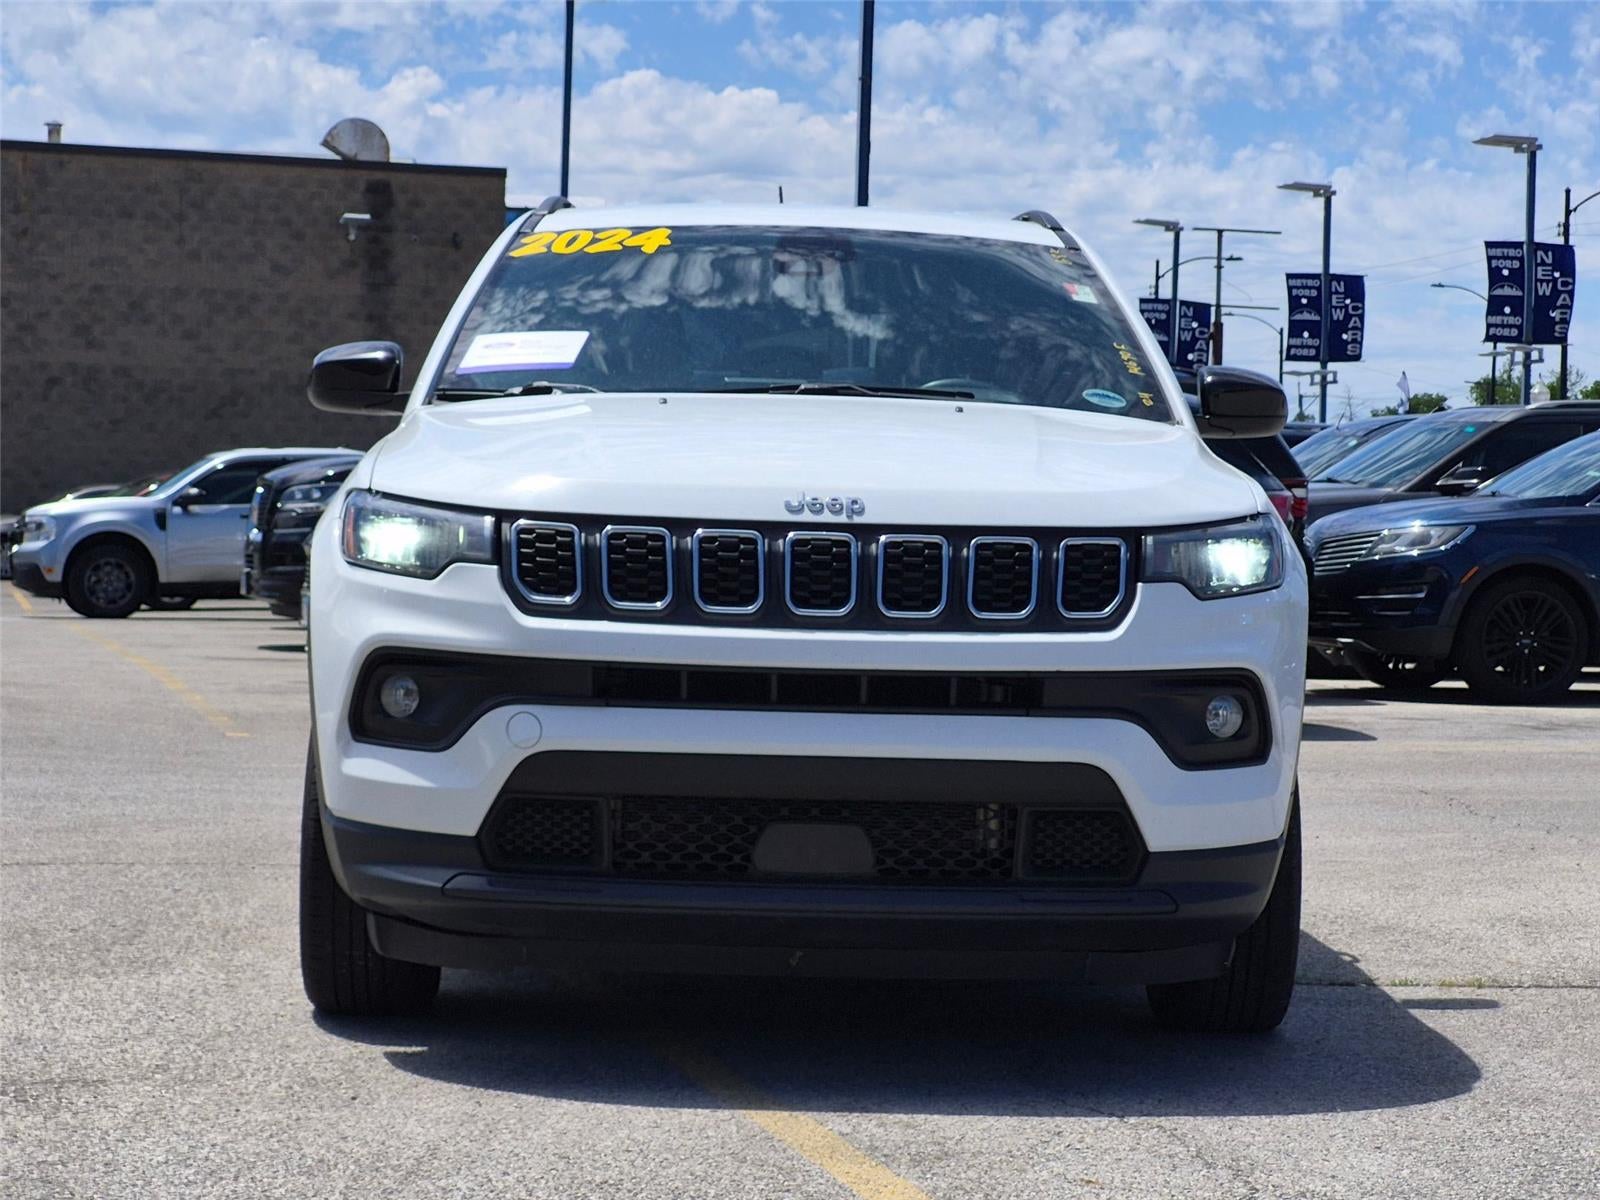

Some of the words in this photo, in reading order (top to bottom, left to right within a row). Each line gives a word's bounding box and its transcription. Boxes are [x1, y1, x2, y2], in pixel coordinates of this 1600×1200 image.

[508, 227, 673, 258] 2024
[1487, 248, 1523, 257] METRO
[1491, 259, 1520, 269] FORD
[1536, 250, 1553, 297] NEW
[1288, 278, 1320, 287] METRO
[1292, 288, 1318, 297] FORD
[1331, 280, 1345, 321] NEW
[1140, 303, 1170, 311] METRO
[1553, 277, 1574, 338] CARS
[1180, 305, 1194, 341] NEW
[1487, 315, 1523, 325] METRO
[1346, 302, 1363, 356] CARS
[1488, 327, 1519, 337] FORD
[1288, 337, 1320, 347] METRO
[1290, 347, 1317, 356] FORD
[784, 491, 866, 521] Jeep
